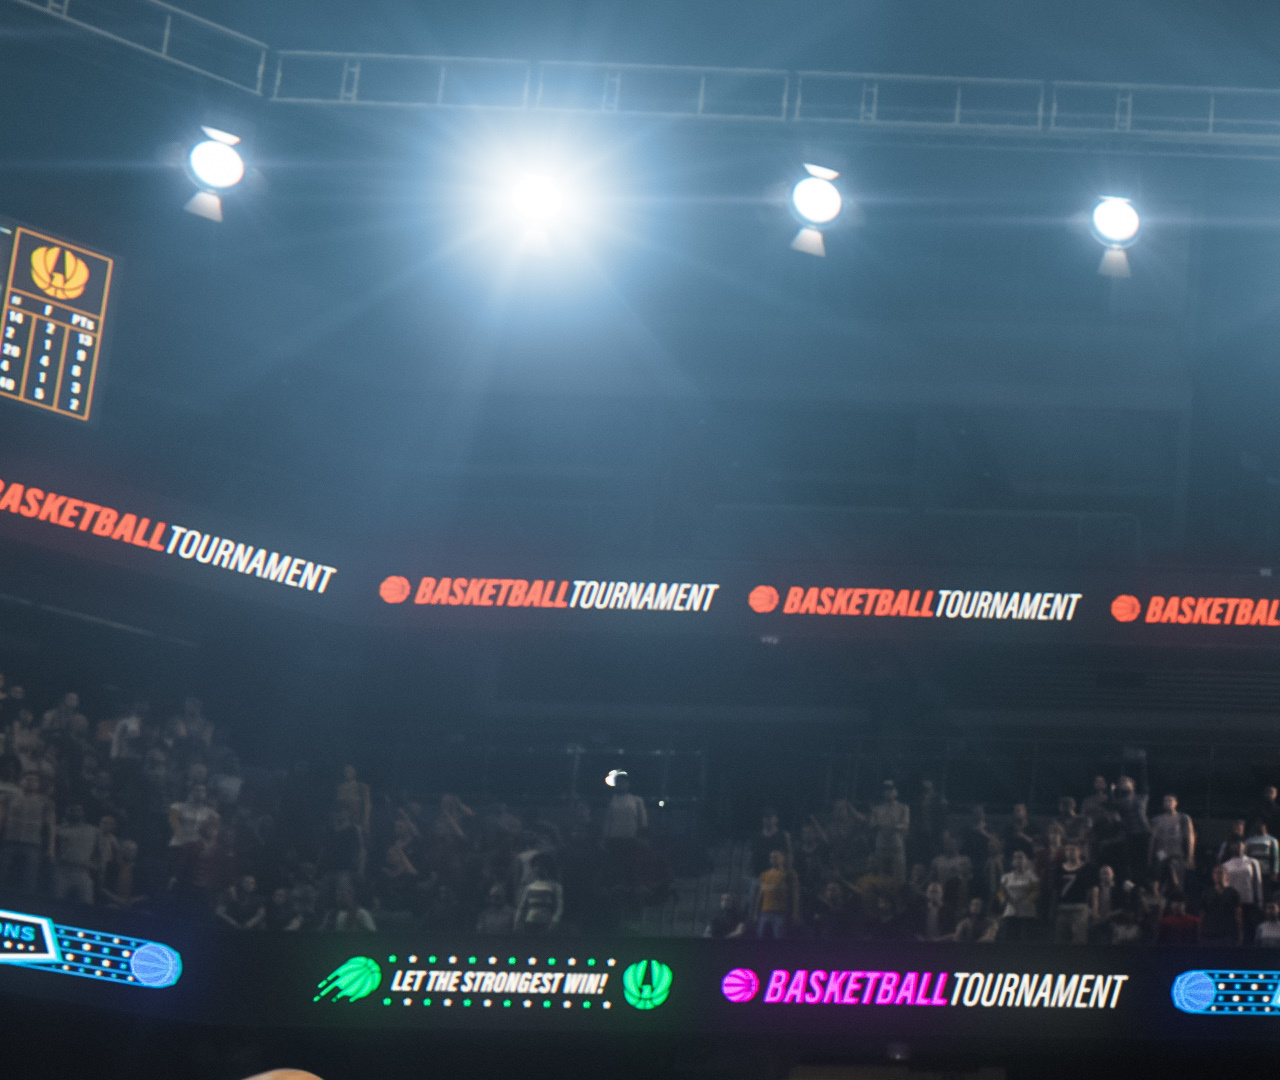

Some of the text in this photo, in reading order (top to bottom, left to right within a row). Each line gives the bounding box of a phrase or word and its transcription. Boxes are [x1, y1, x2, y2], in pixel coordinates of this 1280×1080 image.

[166, 525, 338, 594] TOURNAMENT
[414, 576, 720, 612] BASKETBALL TOURNAMENT
[782, 586, 1083, 621] BASKETBALL TOURNAMENT
[390, 970, 609, 994] LET THE STRONGEST WIN!
[764, 968, 1129, 1009] BASKETBALL TOURNAMENT
